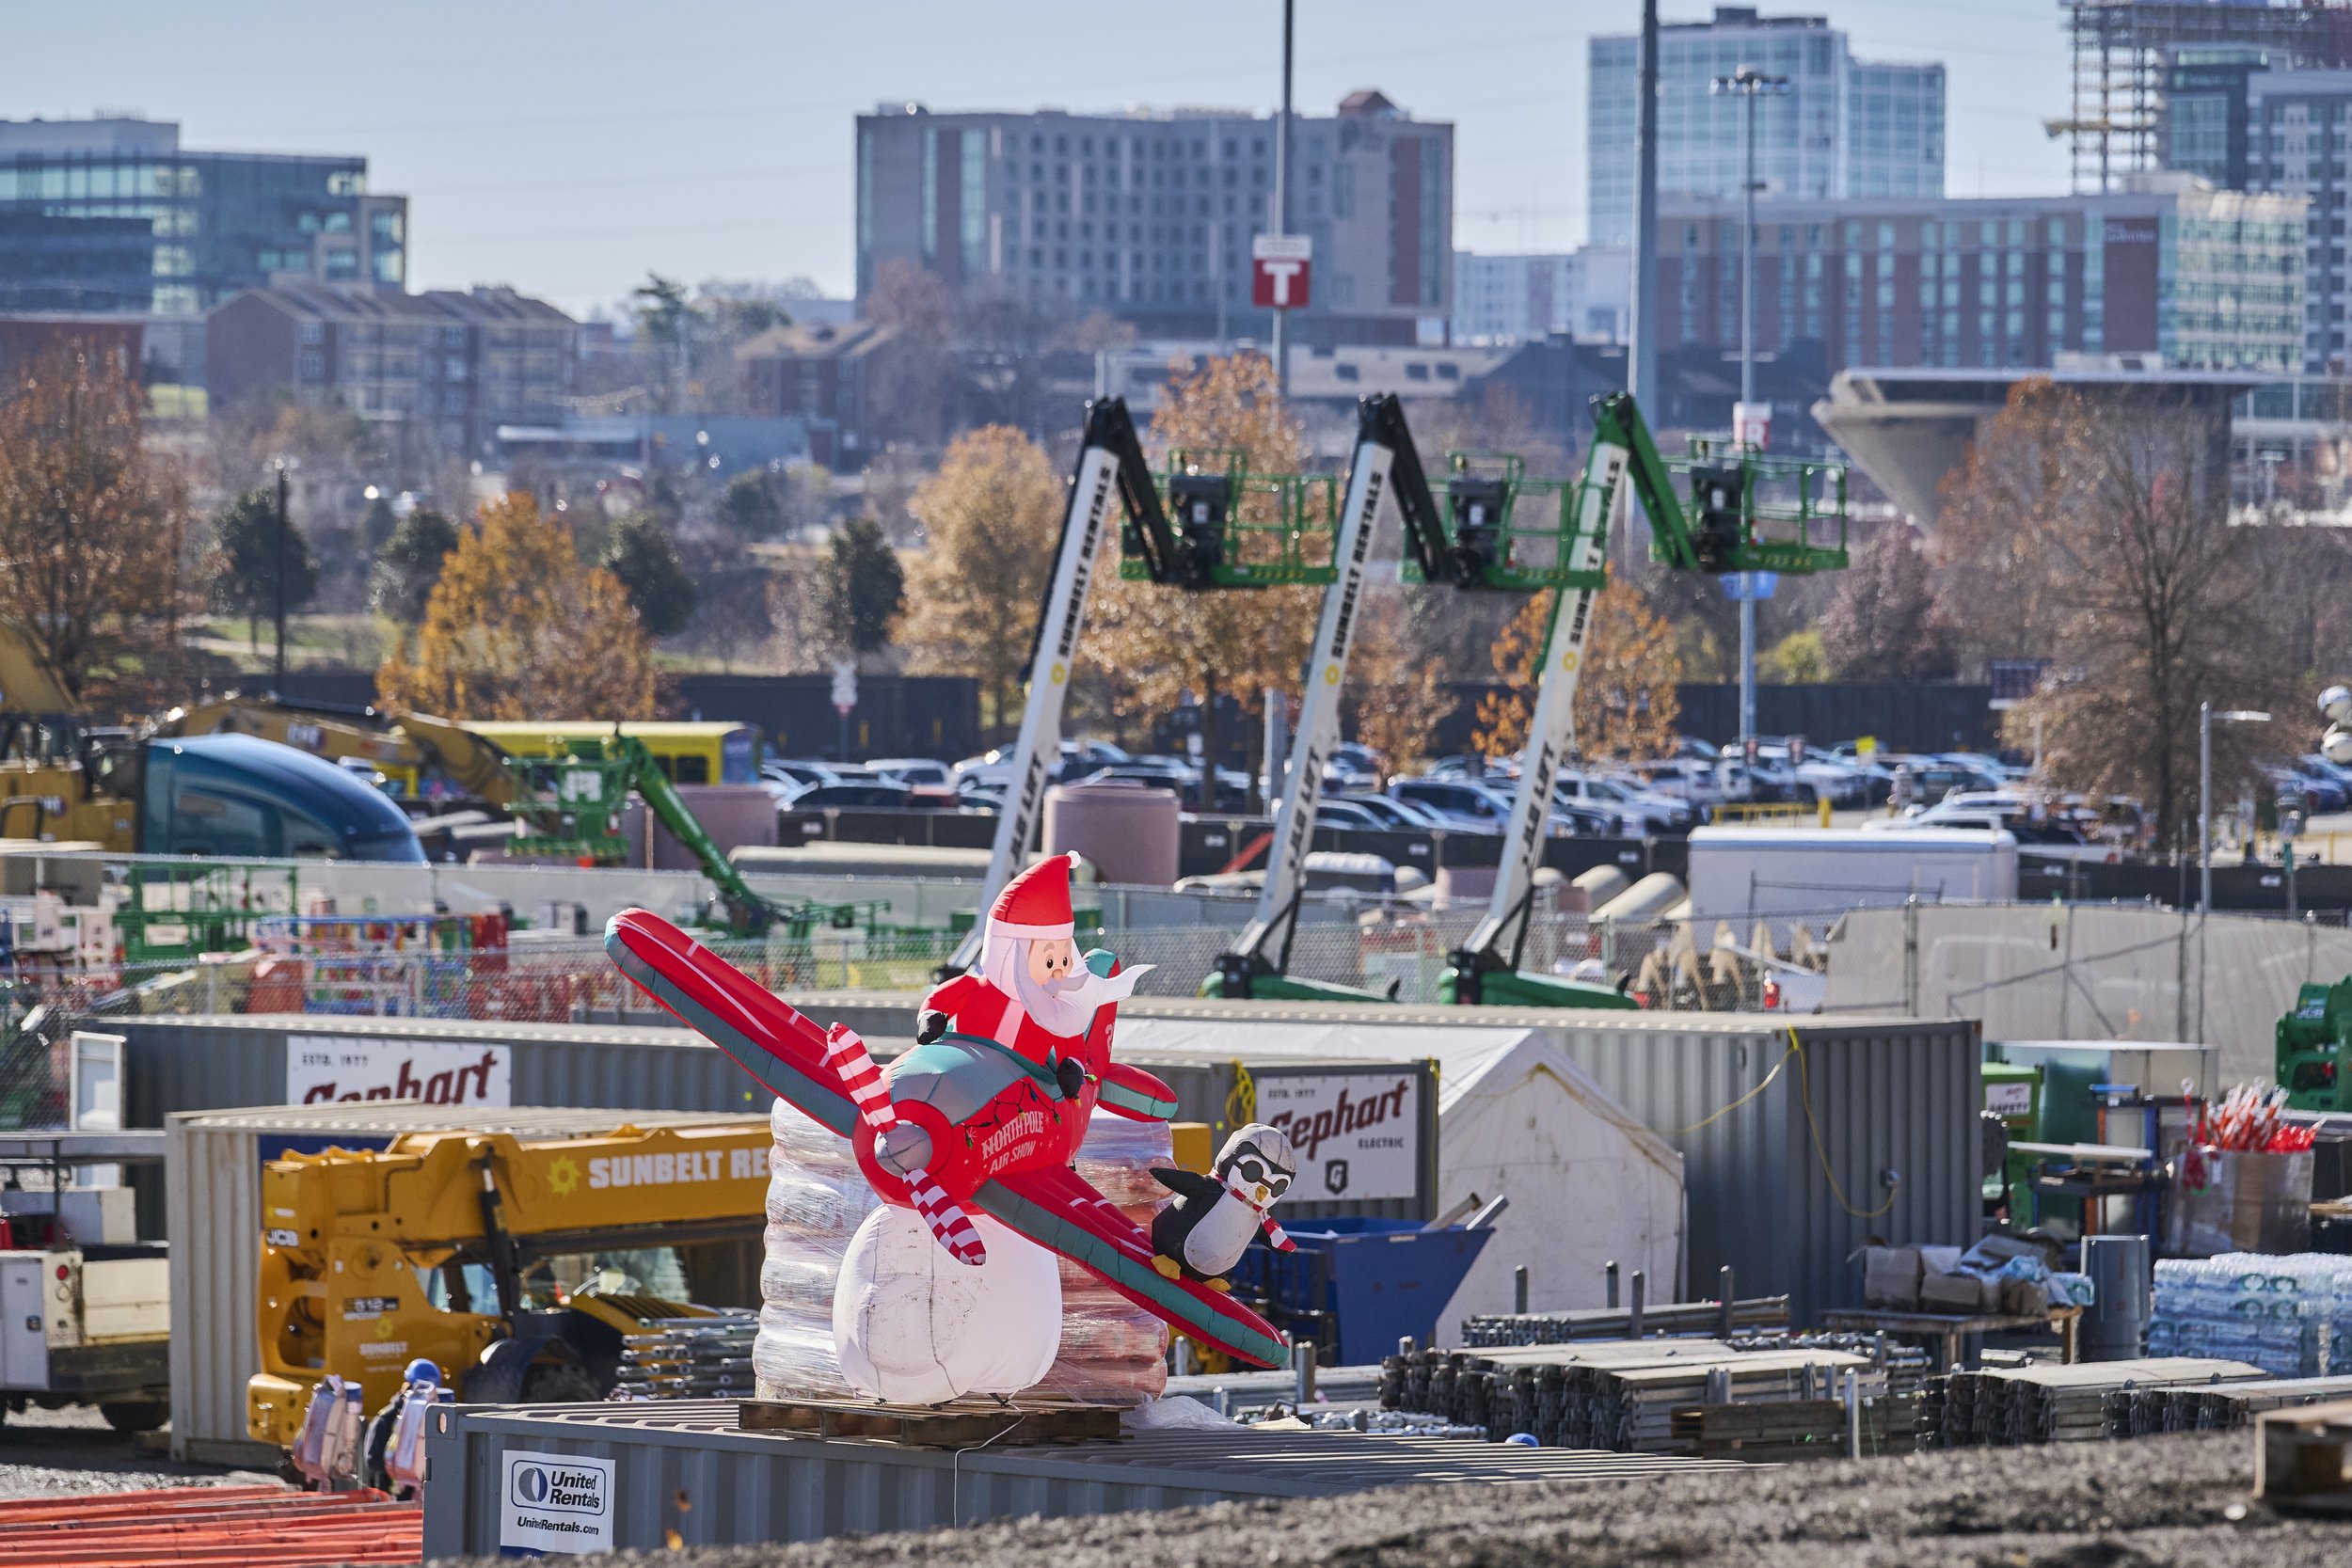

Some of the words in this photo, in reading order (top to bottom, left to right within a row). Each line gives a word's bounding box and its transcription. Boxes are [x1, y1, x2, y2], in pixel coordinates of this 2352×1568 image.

[1263, 261, 1301, 306] T
[1058, 563, 1088, 657] SUNBELT
[1081, 467, 1111, 560] RENTALS
[1331, 567, 1362, 658] SUNBELT
[1353, 471, 1383, 563] RENTALS
[1022, 752, 1042, 812] LIFT
[1301, 747, 1320, 803] LIFT
[1534, 741, 1554, 799] LIFT
[304, 1051, 499, 1104] hart
[981, 1116, 1025, 1162] NORTH
[1023, 1111, 1044, 1135] POLE
[989, 1152, 1010, 1175] AIR
[1010, 1140, 1037, 1163] SHOW
[1358, 1136, 1405, 1149] ELECTRIC
[588, 1149, 723, 1190] SUNBELT
[729, 1147, 771, 1180] RE
[266, 1228, 299, 1246] JCB
[549, 1488, 600, 1509] Rentals
[550, 1470, 597, 1490] United
[516, 1515, 599, 1536] UnitedRentals.com
